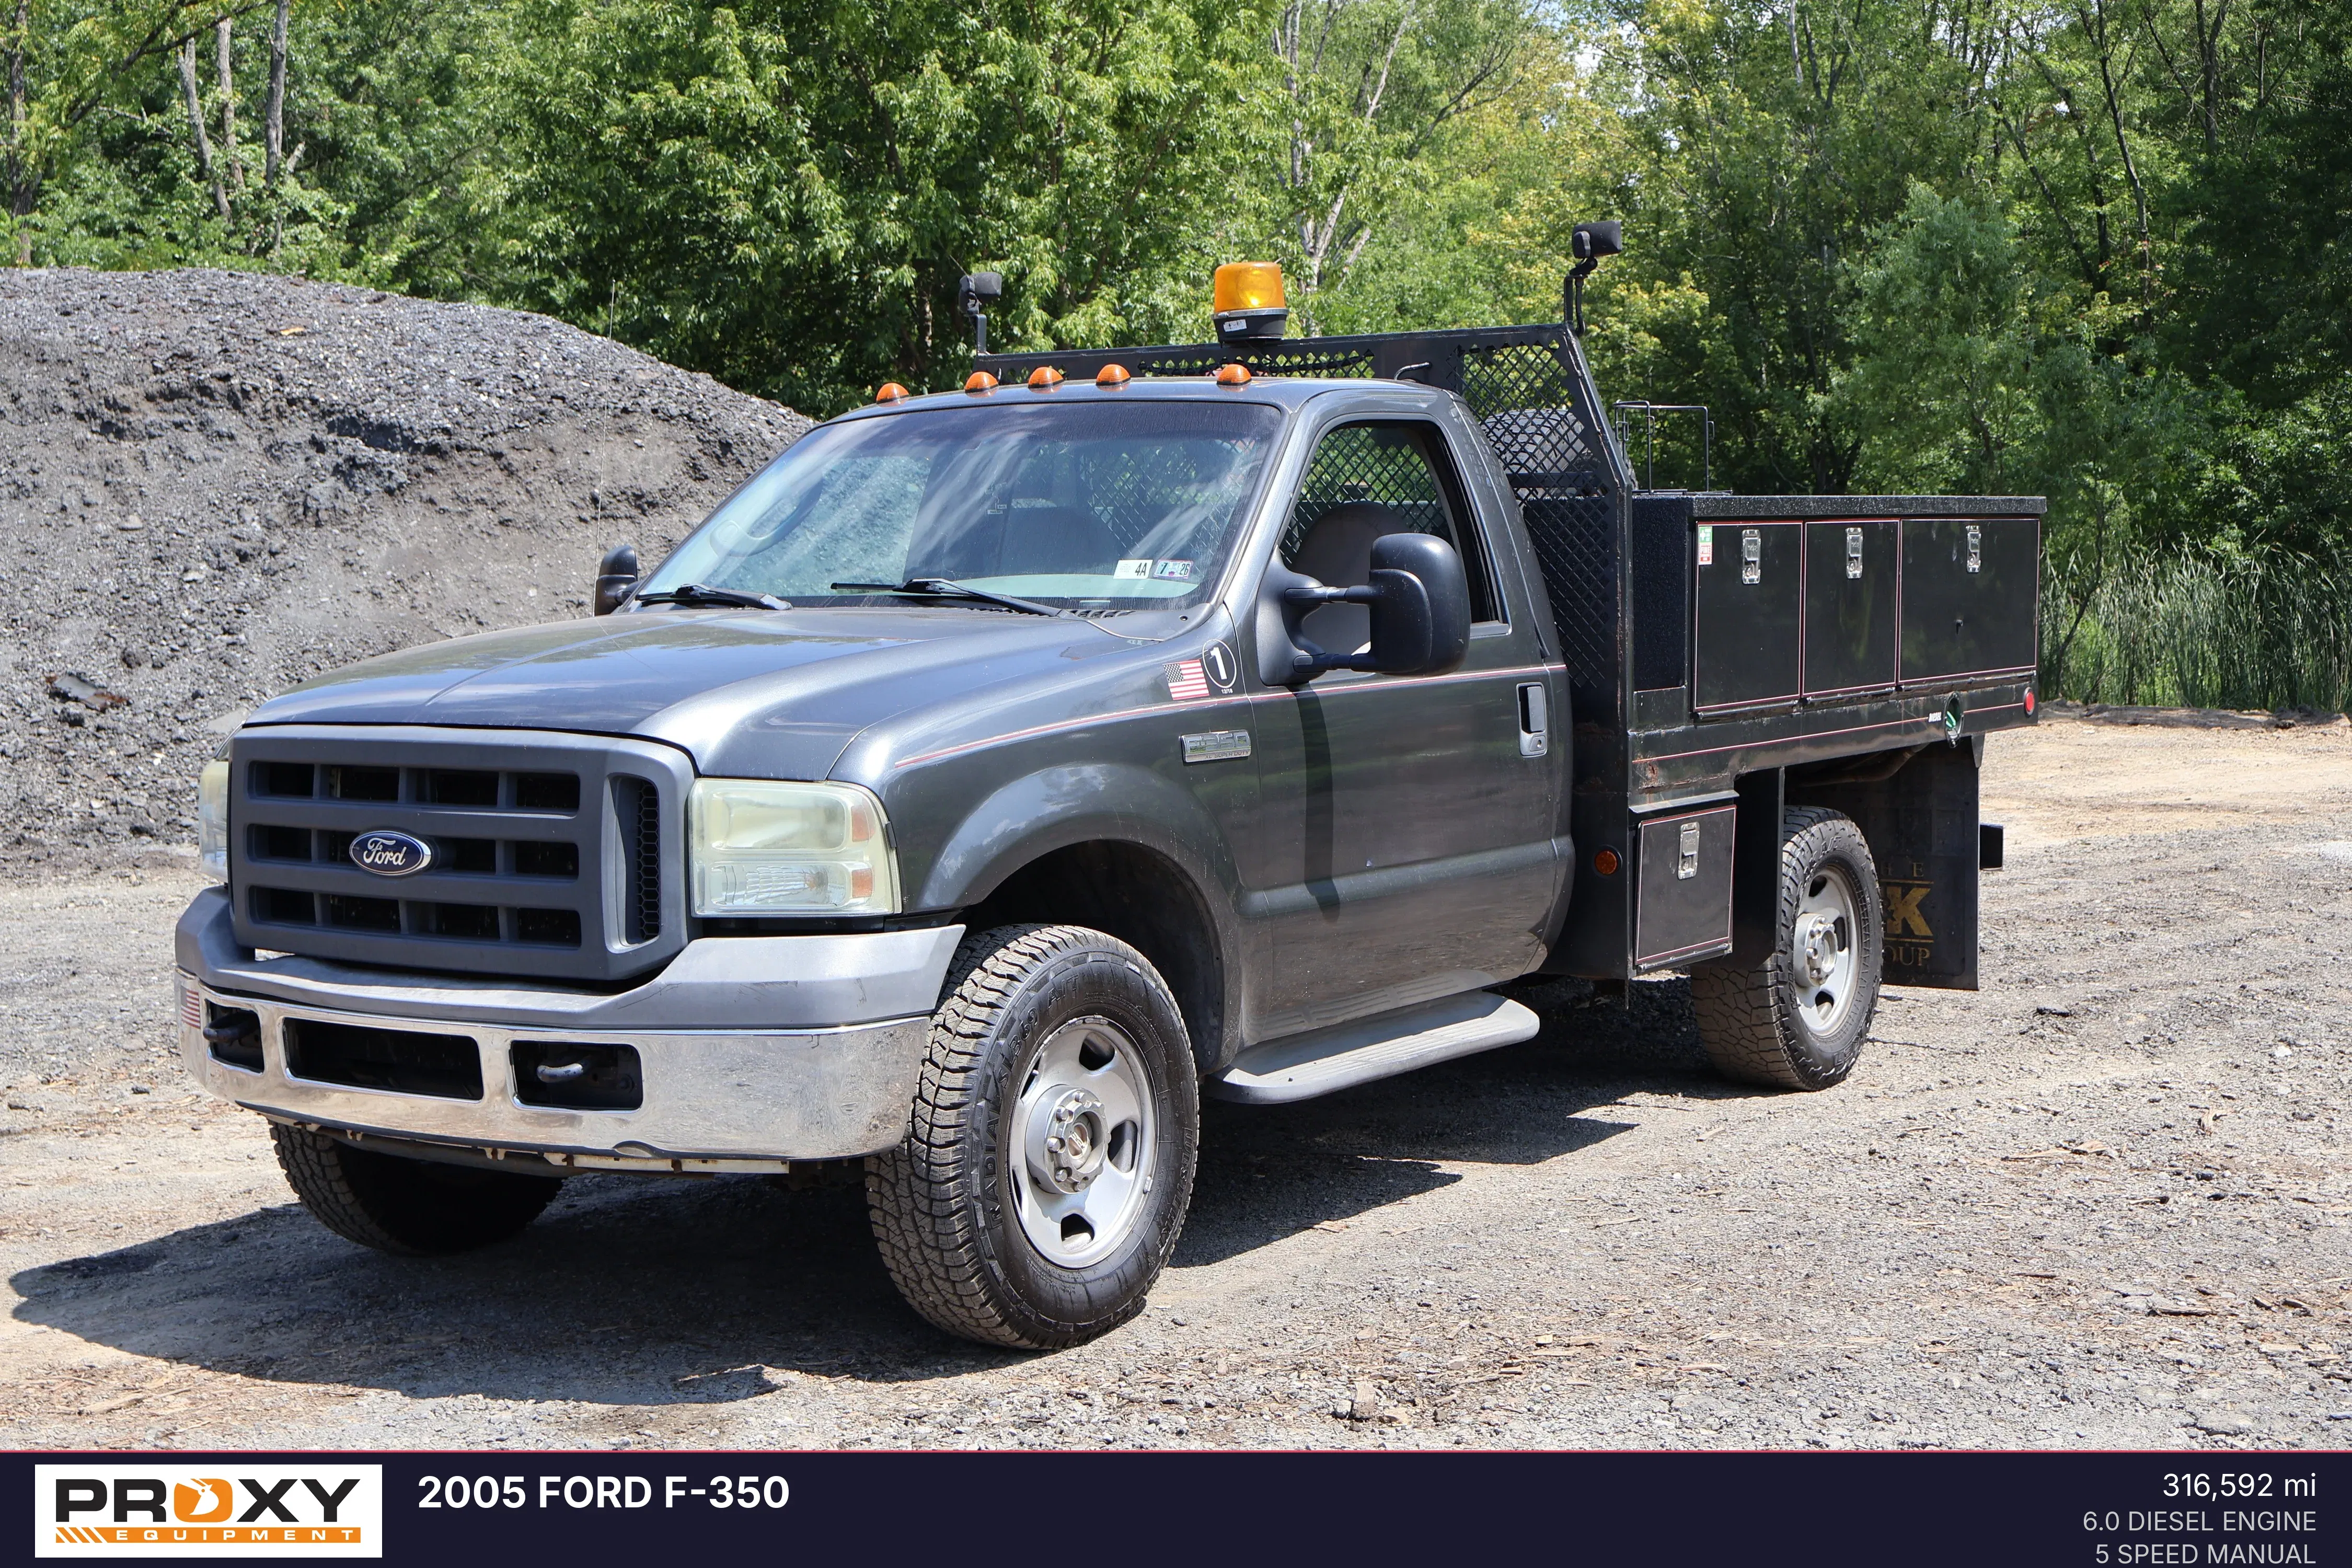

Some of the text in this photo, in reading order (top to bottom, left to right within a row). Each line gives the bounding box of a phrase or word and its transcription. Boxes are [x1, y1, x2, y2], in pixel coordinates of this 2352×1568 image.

[1135, 562, 1147, 576] 4A
[1160, 562, 1190, 575] 7 26
[1210, 647, 1228, 680] 1
[363, 838, 407, 866] Ford
[1883, 944, 1931, 966] OUP
